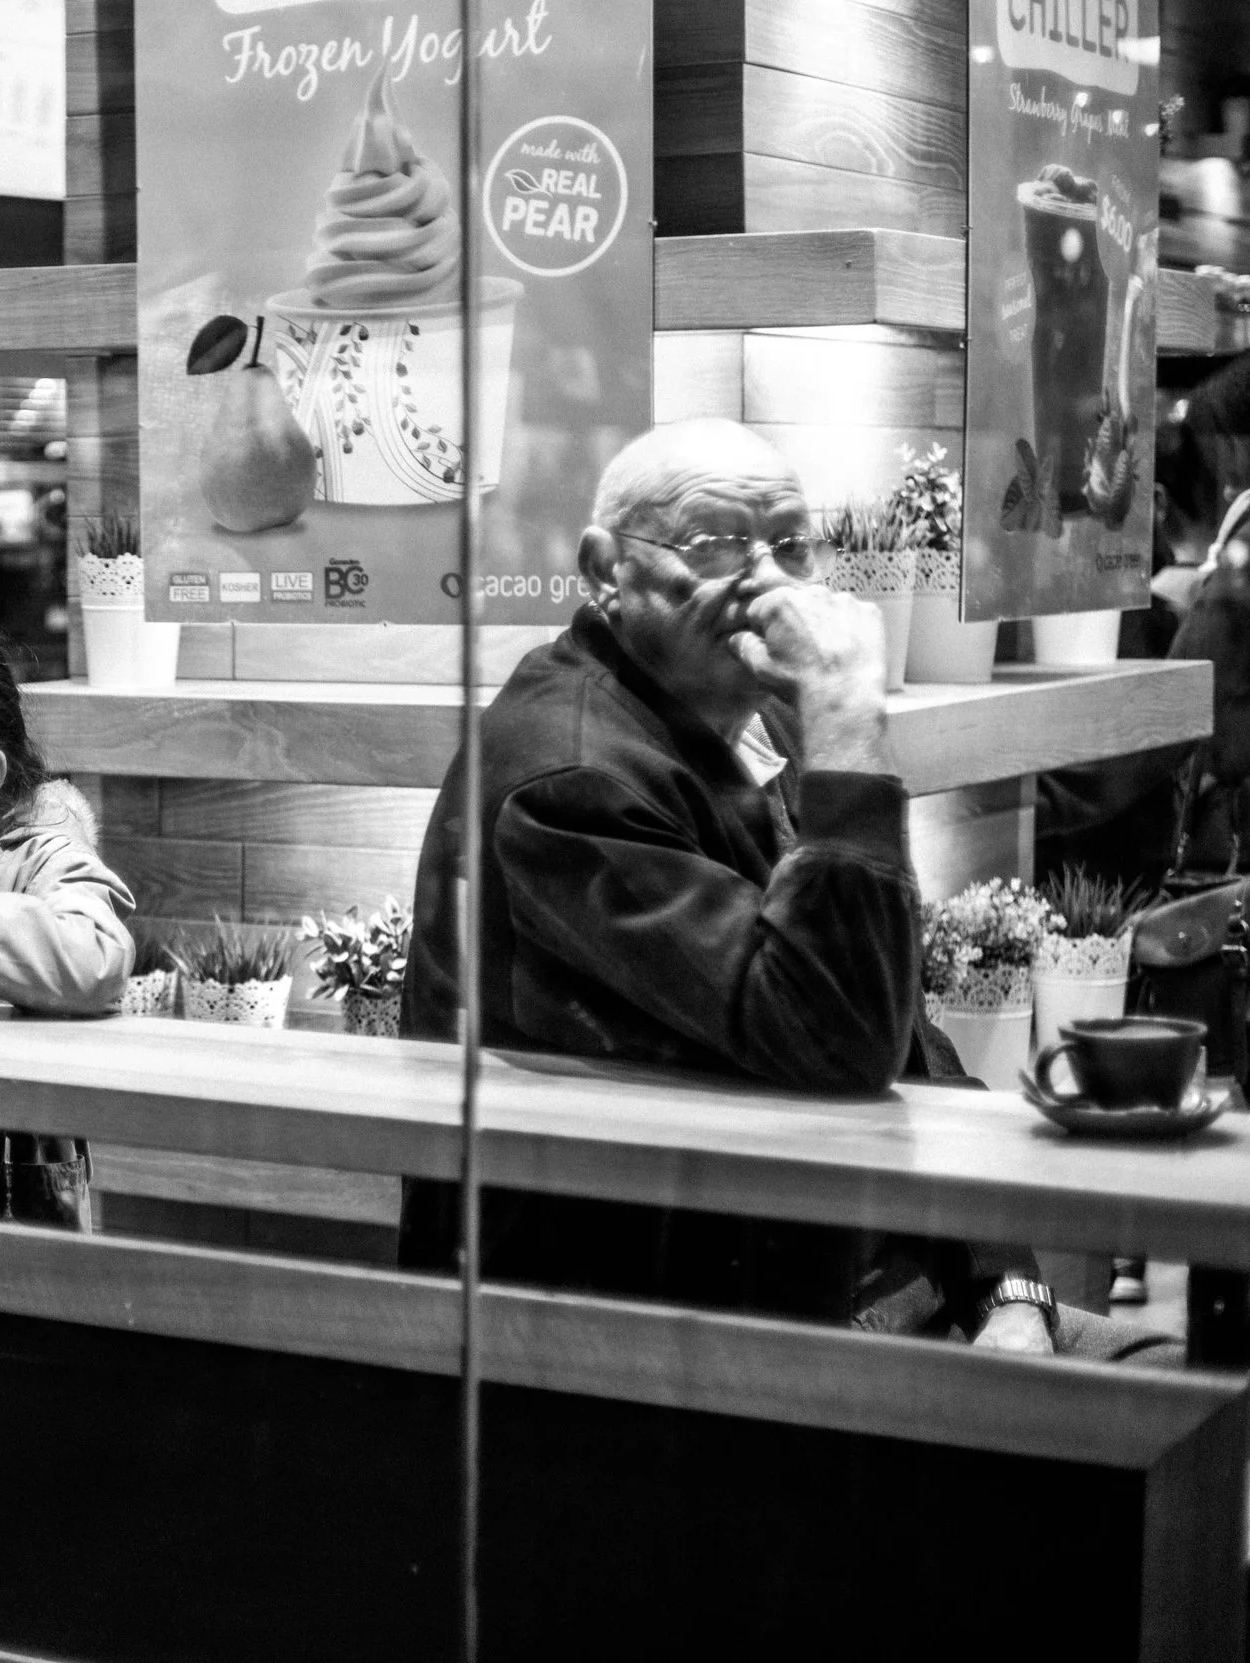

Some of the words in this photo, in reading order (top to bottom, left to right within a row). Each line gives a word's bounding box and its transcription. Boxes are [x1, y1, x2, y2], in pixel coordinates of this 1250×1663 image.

[222, 25, 373, 101] Frozen
[382, 0, 552, 85] Yogurt
[520, 138, 563, 160] made
[564, 141, 601, 164] with
[541, 167, 602, 199] REAL
[502, 195, 599, 243] PEAR
[222, 581, 259, 593] KOSHER
[275, 573, 308, 588] LIVE
[173, 587, 207, 601] FREE
